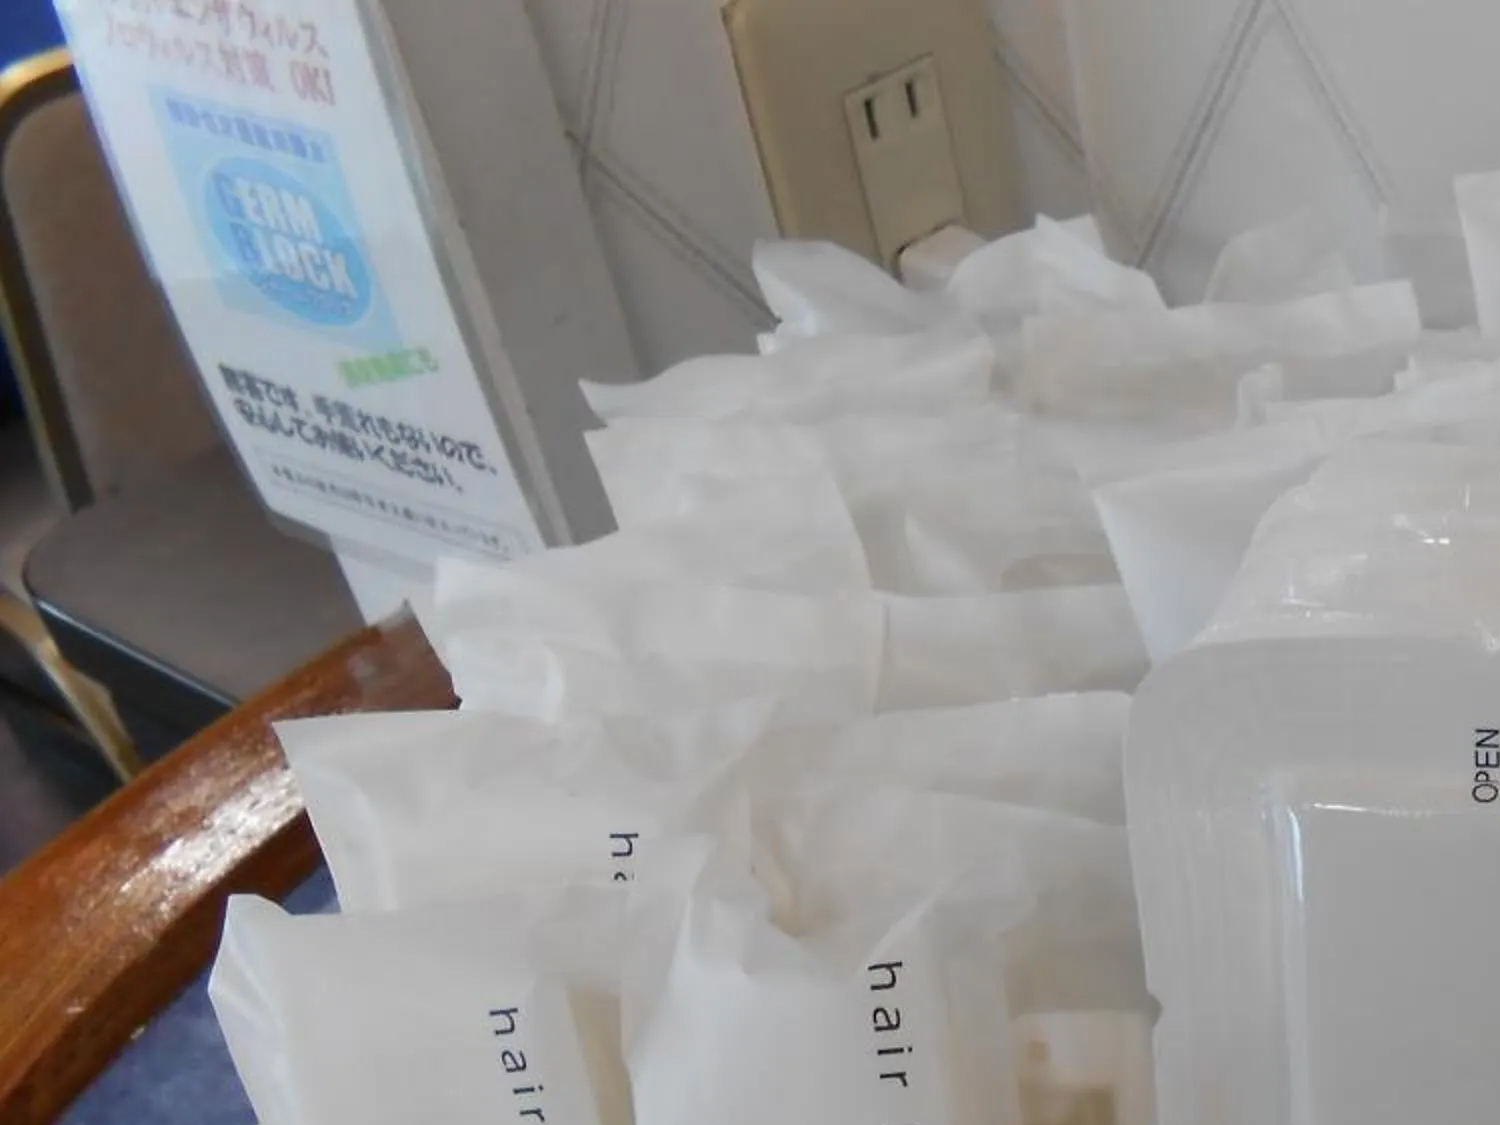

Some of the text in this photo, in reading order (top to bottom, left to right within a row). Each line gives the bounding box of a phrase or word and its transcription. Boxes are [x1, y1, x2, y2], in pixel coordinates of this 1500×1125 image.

[213, 172, 324, 247] GERM
[230, 222, 359, 299] BLOCK
[1473, 727, 1500, 803] OPEN
[868, 961, 914, 1088] hair
[489, 1007, 545, 1123] hair
